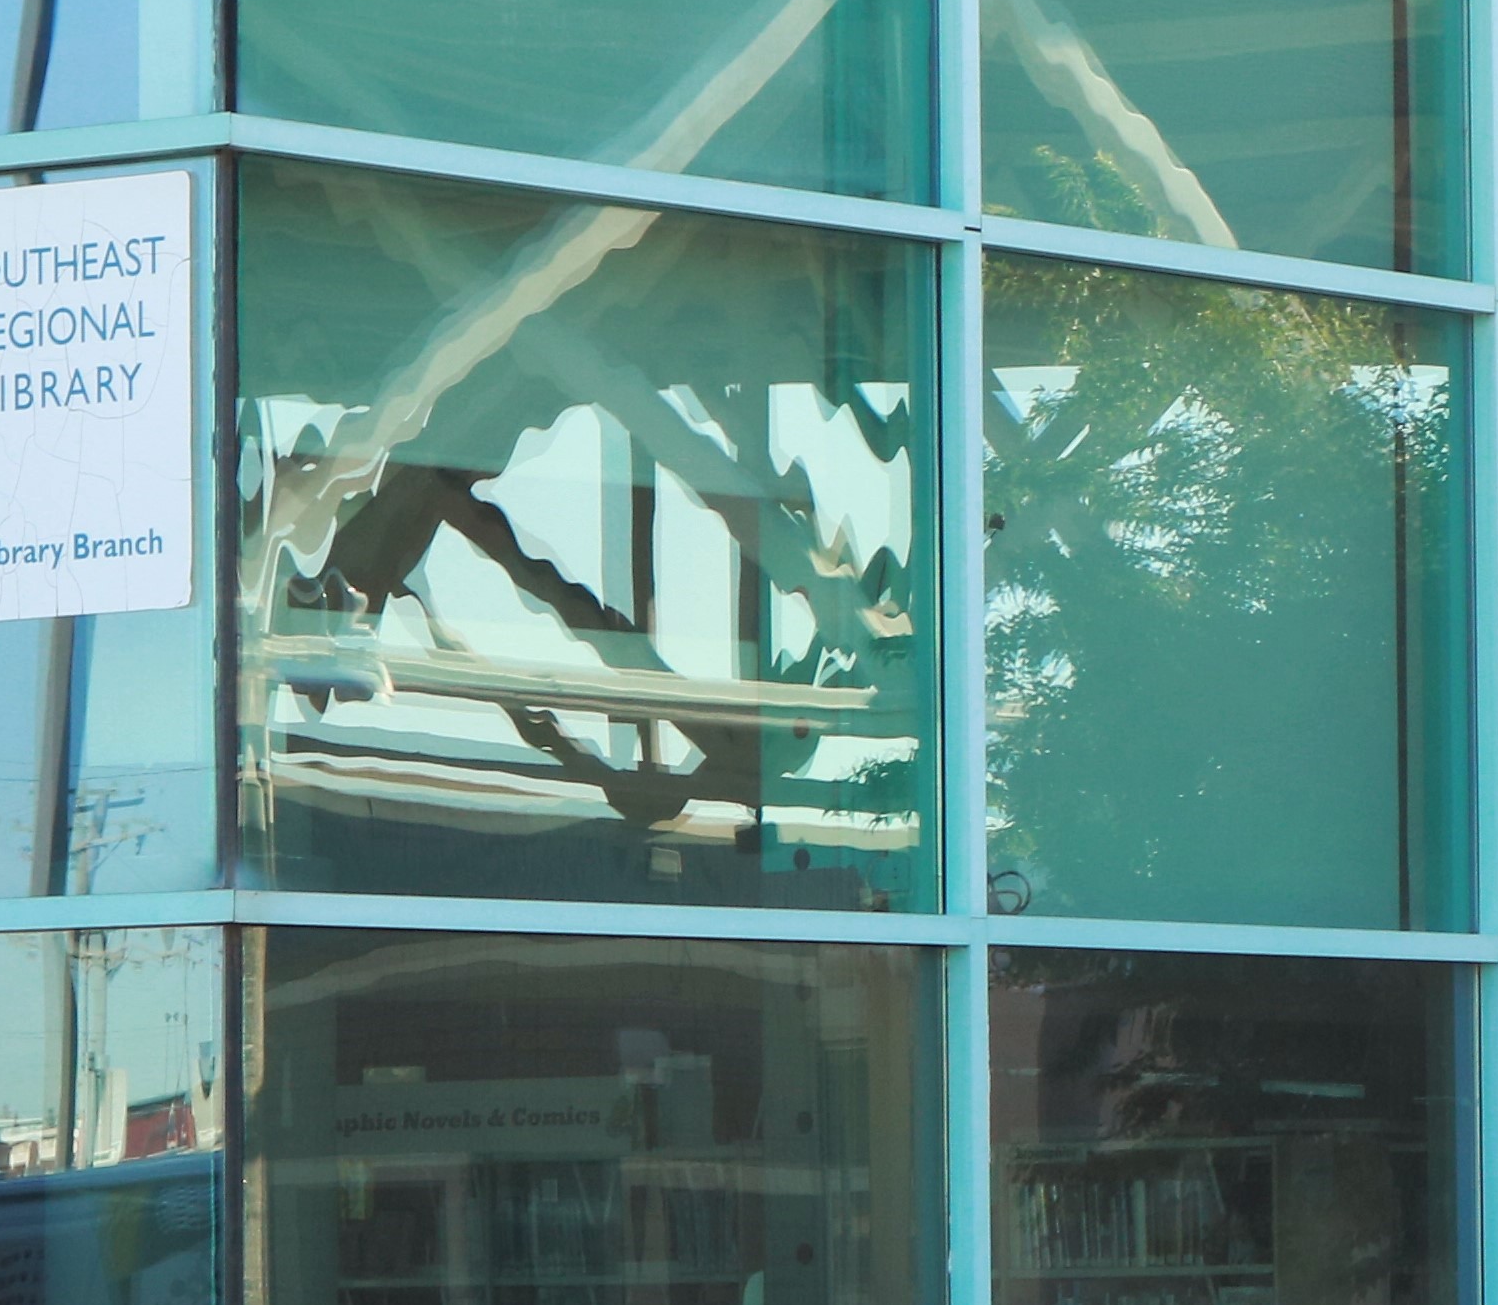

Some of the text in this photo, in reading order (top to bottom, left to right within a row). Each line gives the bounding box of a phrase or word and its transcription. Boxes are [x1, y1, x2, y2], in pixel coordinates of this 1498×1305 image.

[72, 528, 164, 560] Branch
[402, 1108, 482, 1131] Novels
[486, 1106, 506, 1127] &
[509, 1103, 601, 1127] Comics
